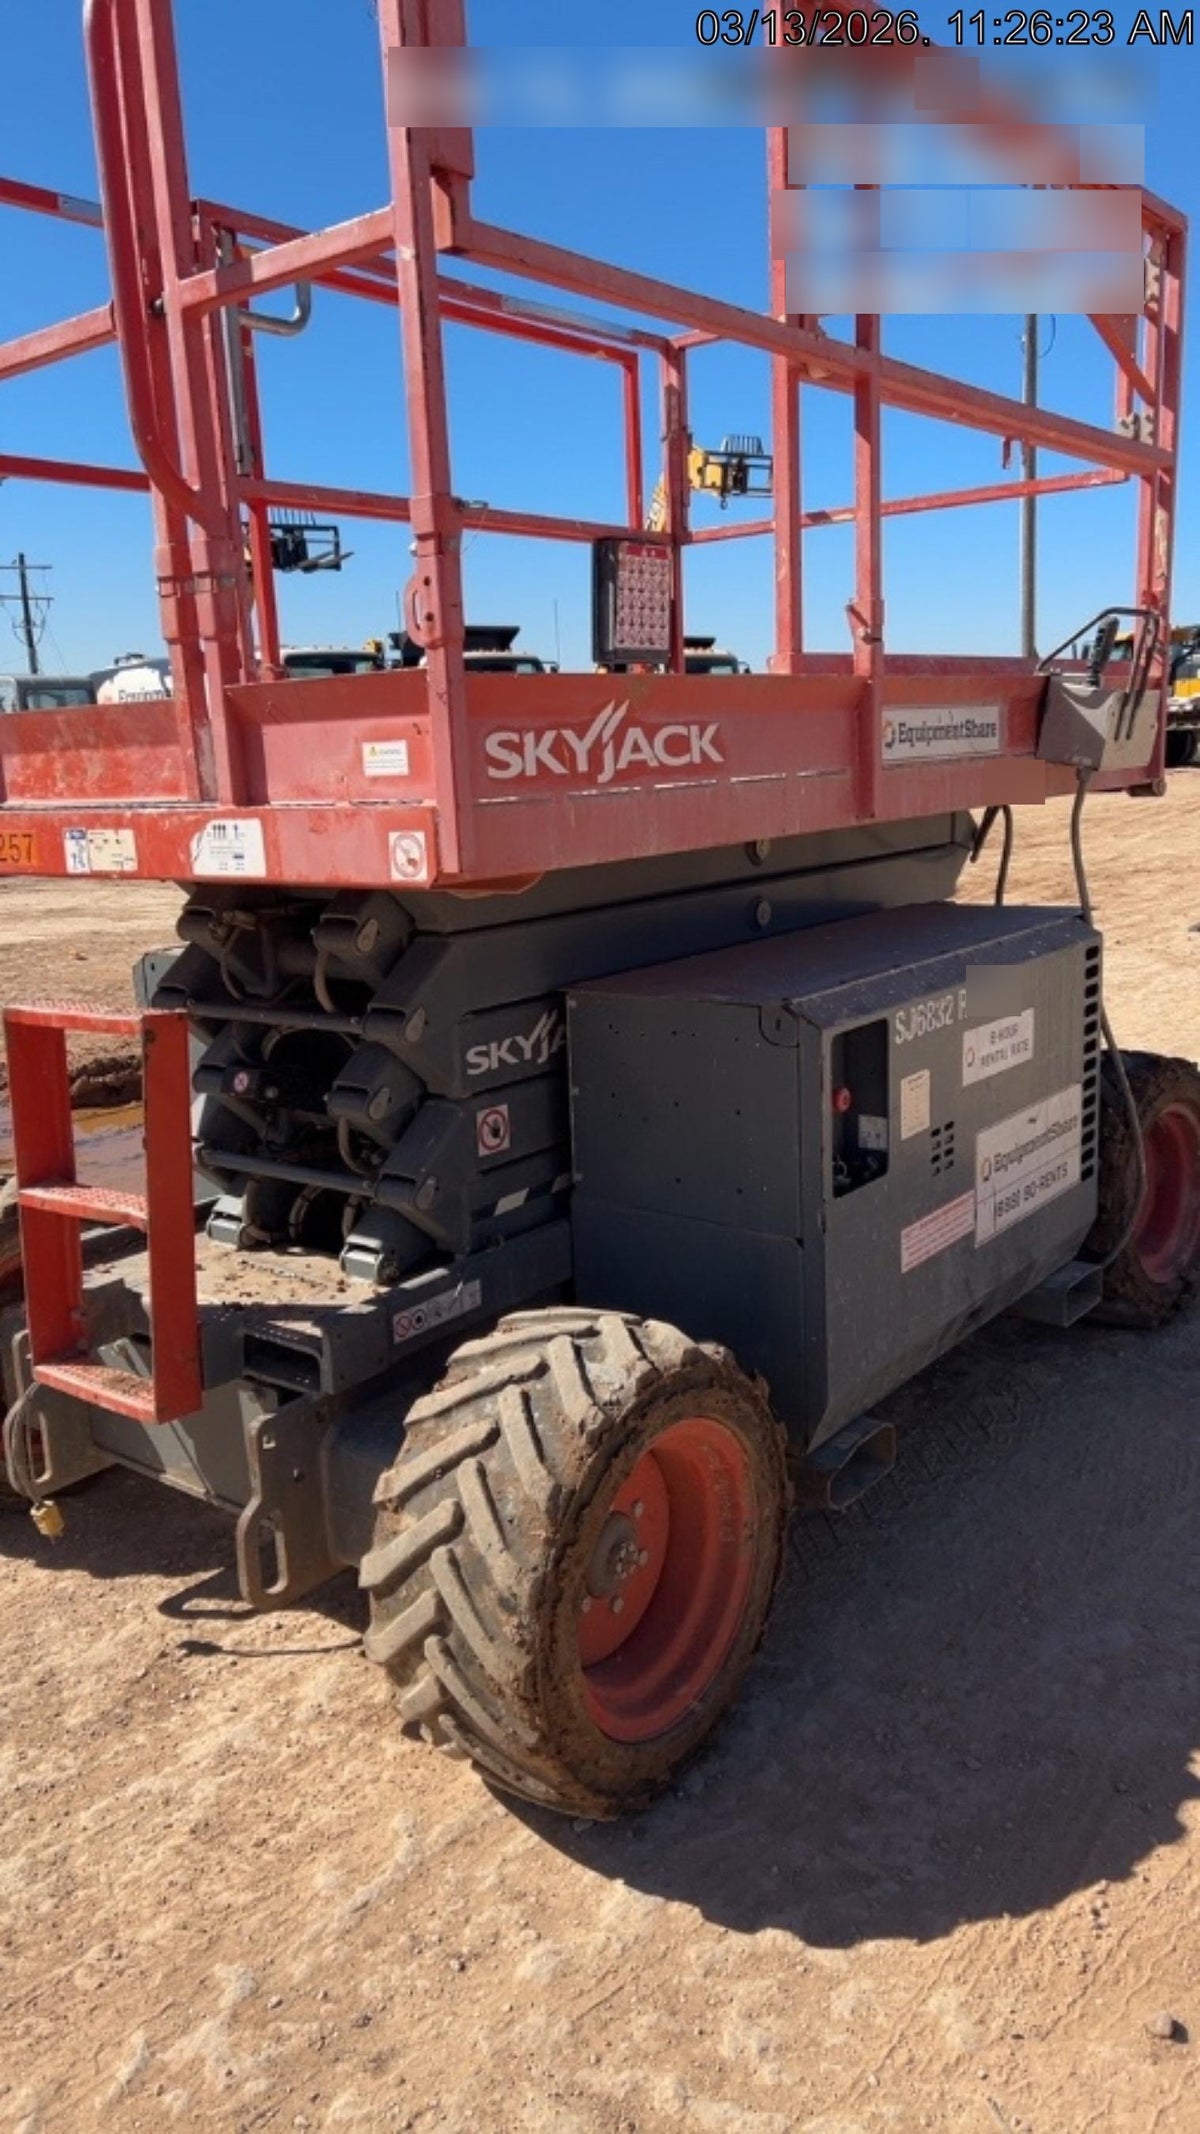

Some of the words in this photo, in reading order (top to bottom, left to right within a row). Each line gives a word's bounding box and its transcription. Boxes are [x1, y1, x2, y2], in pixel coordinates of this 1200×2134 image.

[485, 699, 725, 784] SKYJACK
[898, 717, 997, 748] EquipmentShare
[466, 1009, 566, 1075] SKYJA
[895, 995, 954, 1045] SJ6832
[1010, 1038, 1030, 1056] RATE
[993, 1115, 1079, 1173] EquipmentShare
